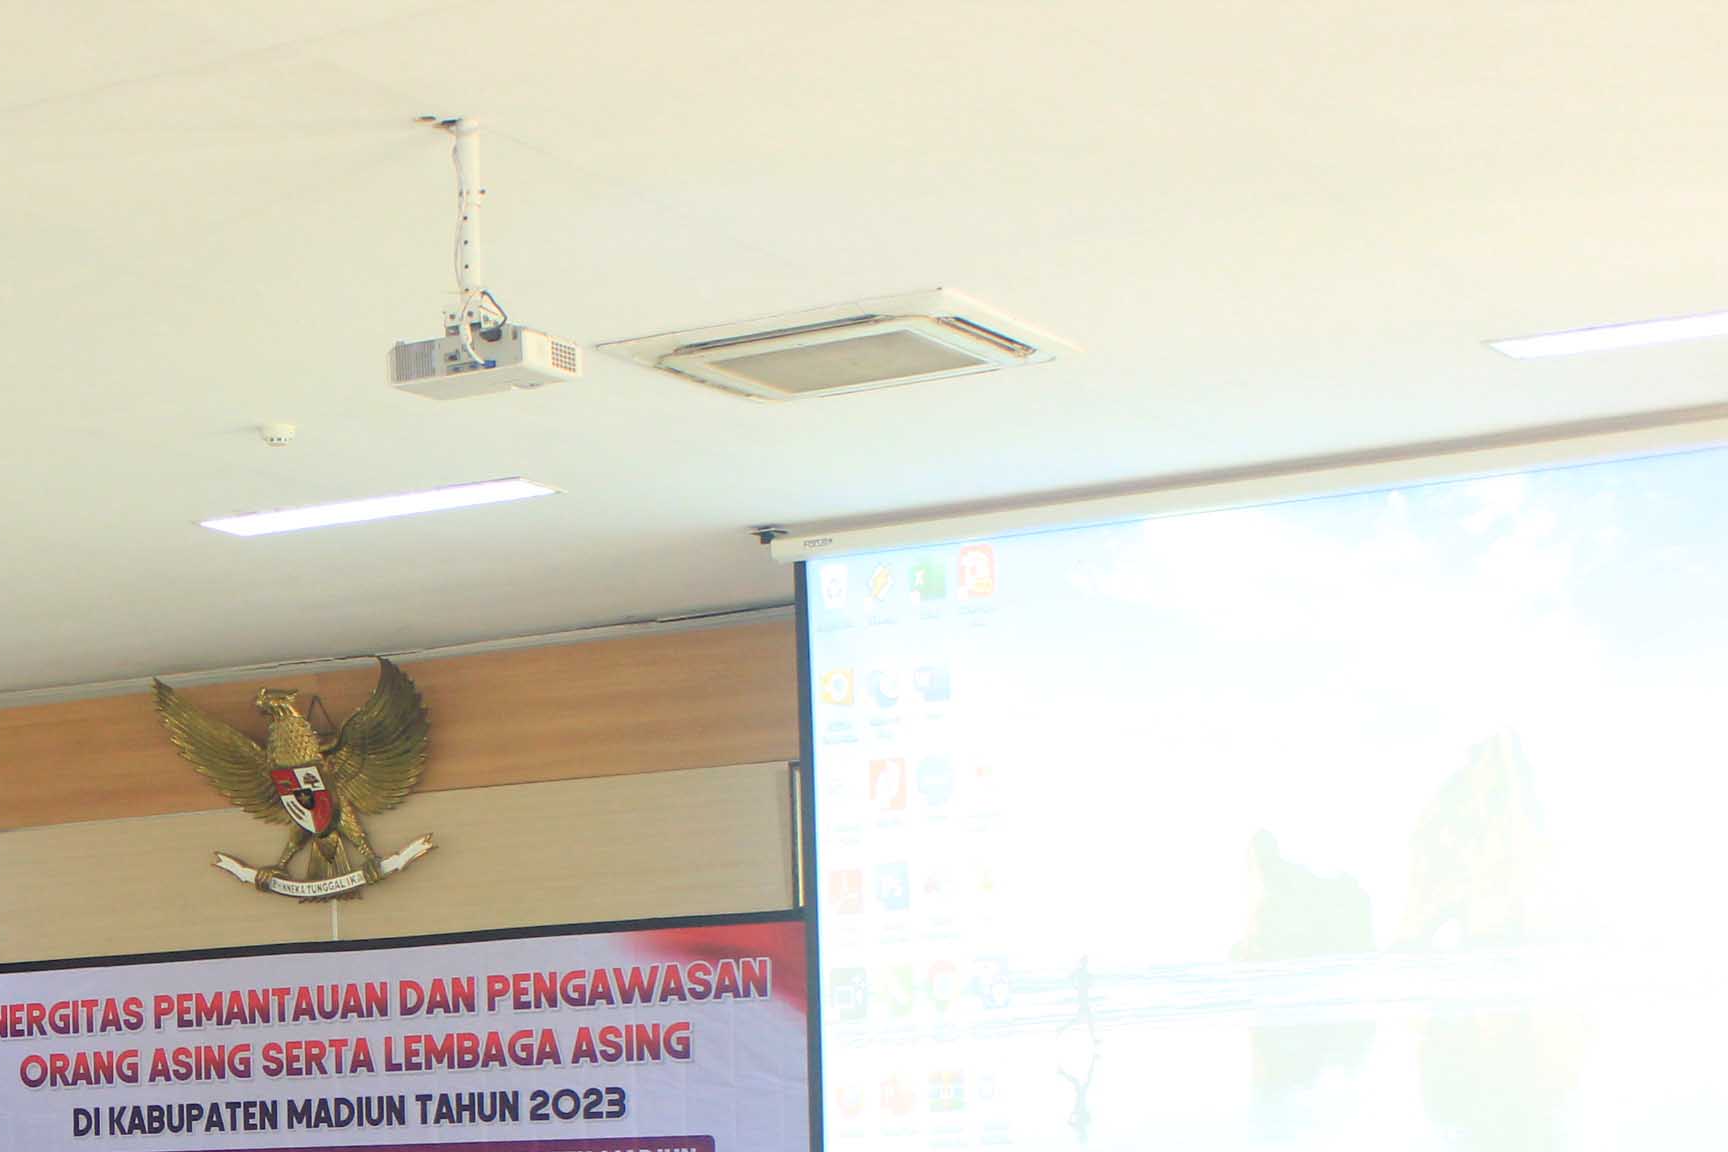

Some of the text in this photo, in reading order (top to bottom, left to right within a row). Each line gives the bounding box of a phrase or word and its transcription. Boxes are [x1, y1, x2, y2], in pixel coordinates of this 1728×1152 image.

[154, 982, 388, 1028] PEMANTAUAN
[399, 976, 475, 1016] DAN
[487, 957, 769, 1012] PENGAWASAN
[20, 1021, 692, 1088] ORANG ASING SERTA LEMBAGA ASING
[72, 1086, 626, 1137] DI KABUPATEN MADIUN TAHUN 2023
